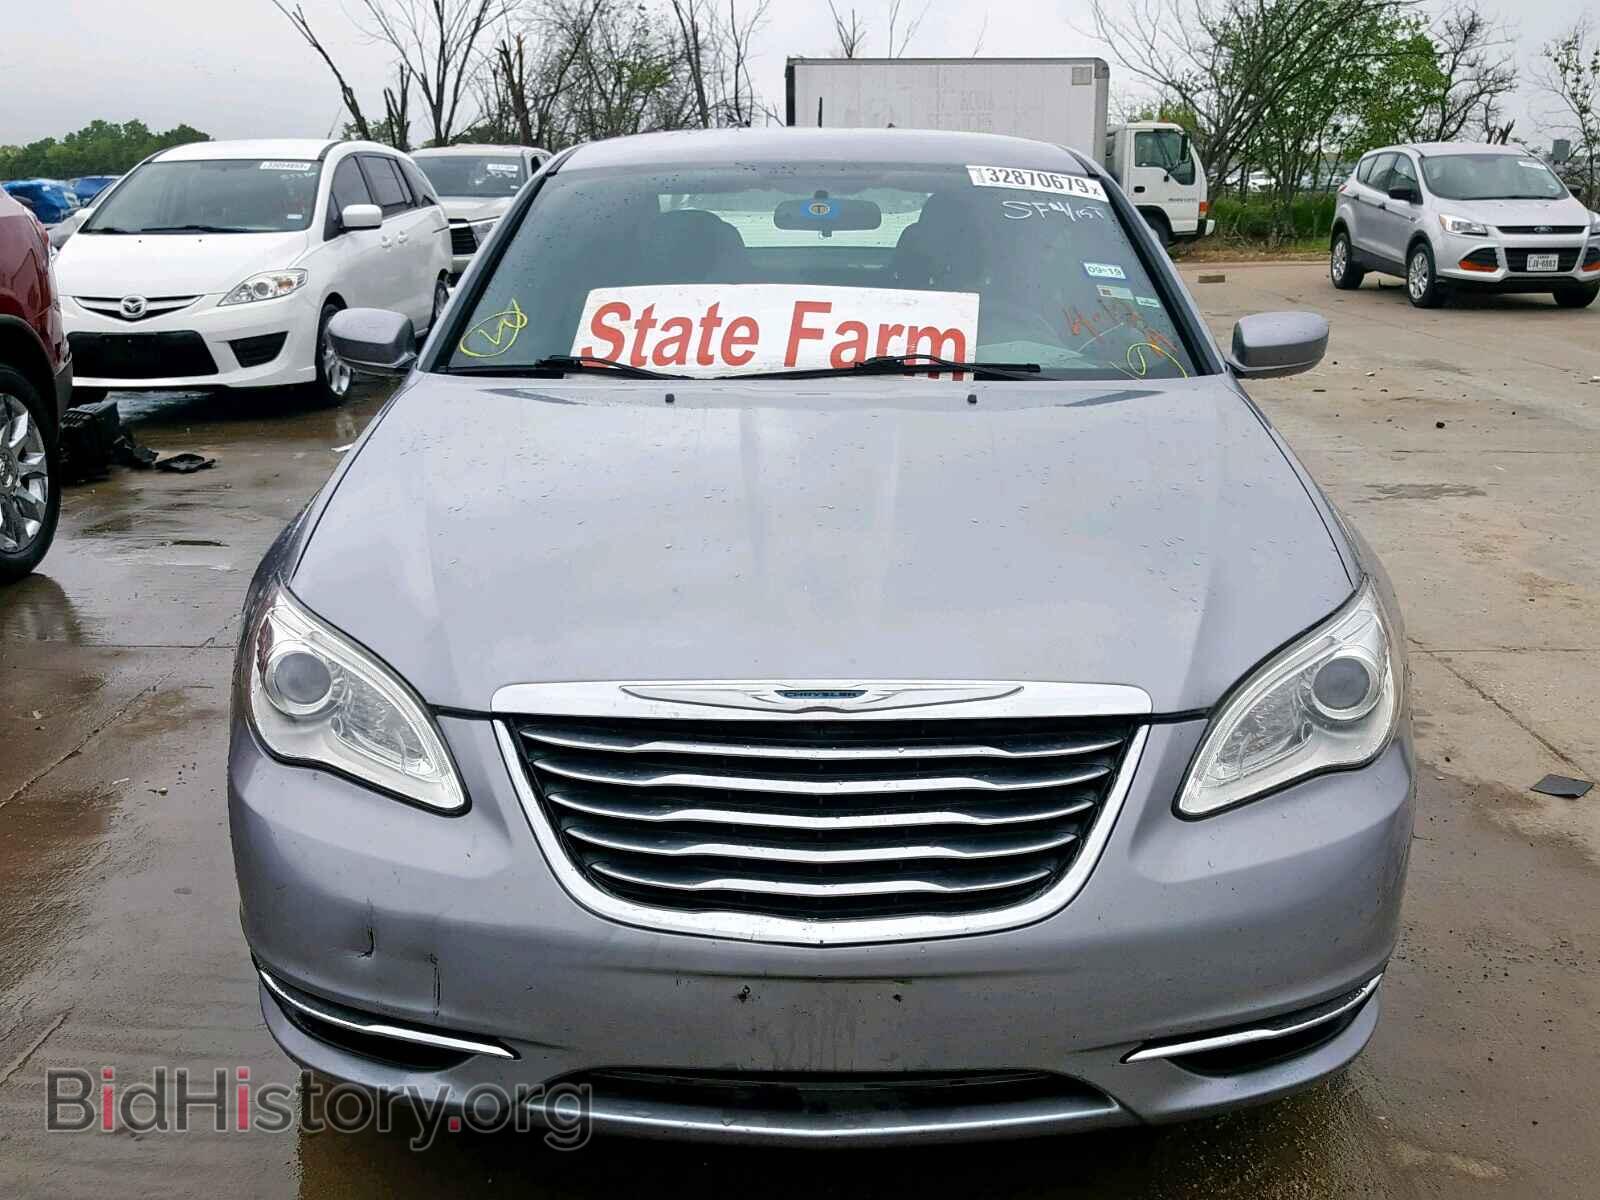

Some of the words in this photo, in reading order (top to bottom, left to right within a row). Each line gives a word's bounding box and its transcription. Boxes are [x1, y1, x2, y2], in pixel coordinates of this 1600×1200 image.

[985, 168, 1089, 194] 32870679
[581, 301, 760, 369] State
[783, 300, 967, 382] Farm
[786, 690, 857, 698] CHRYSLER
